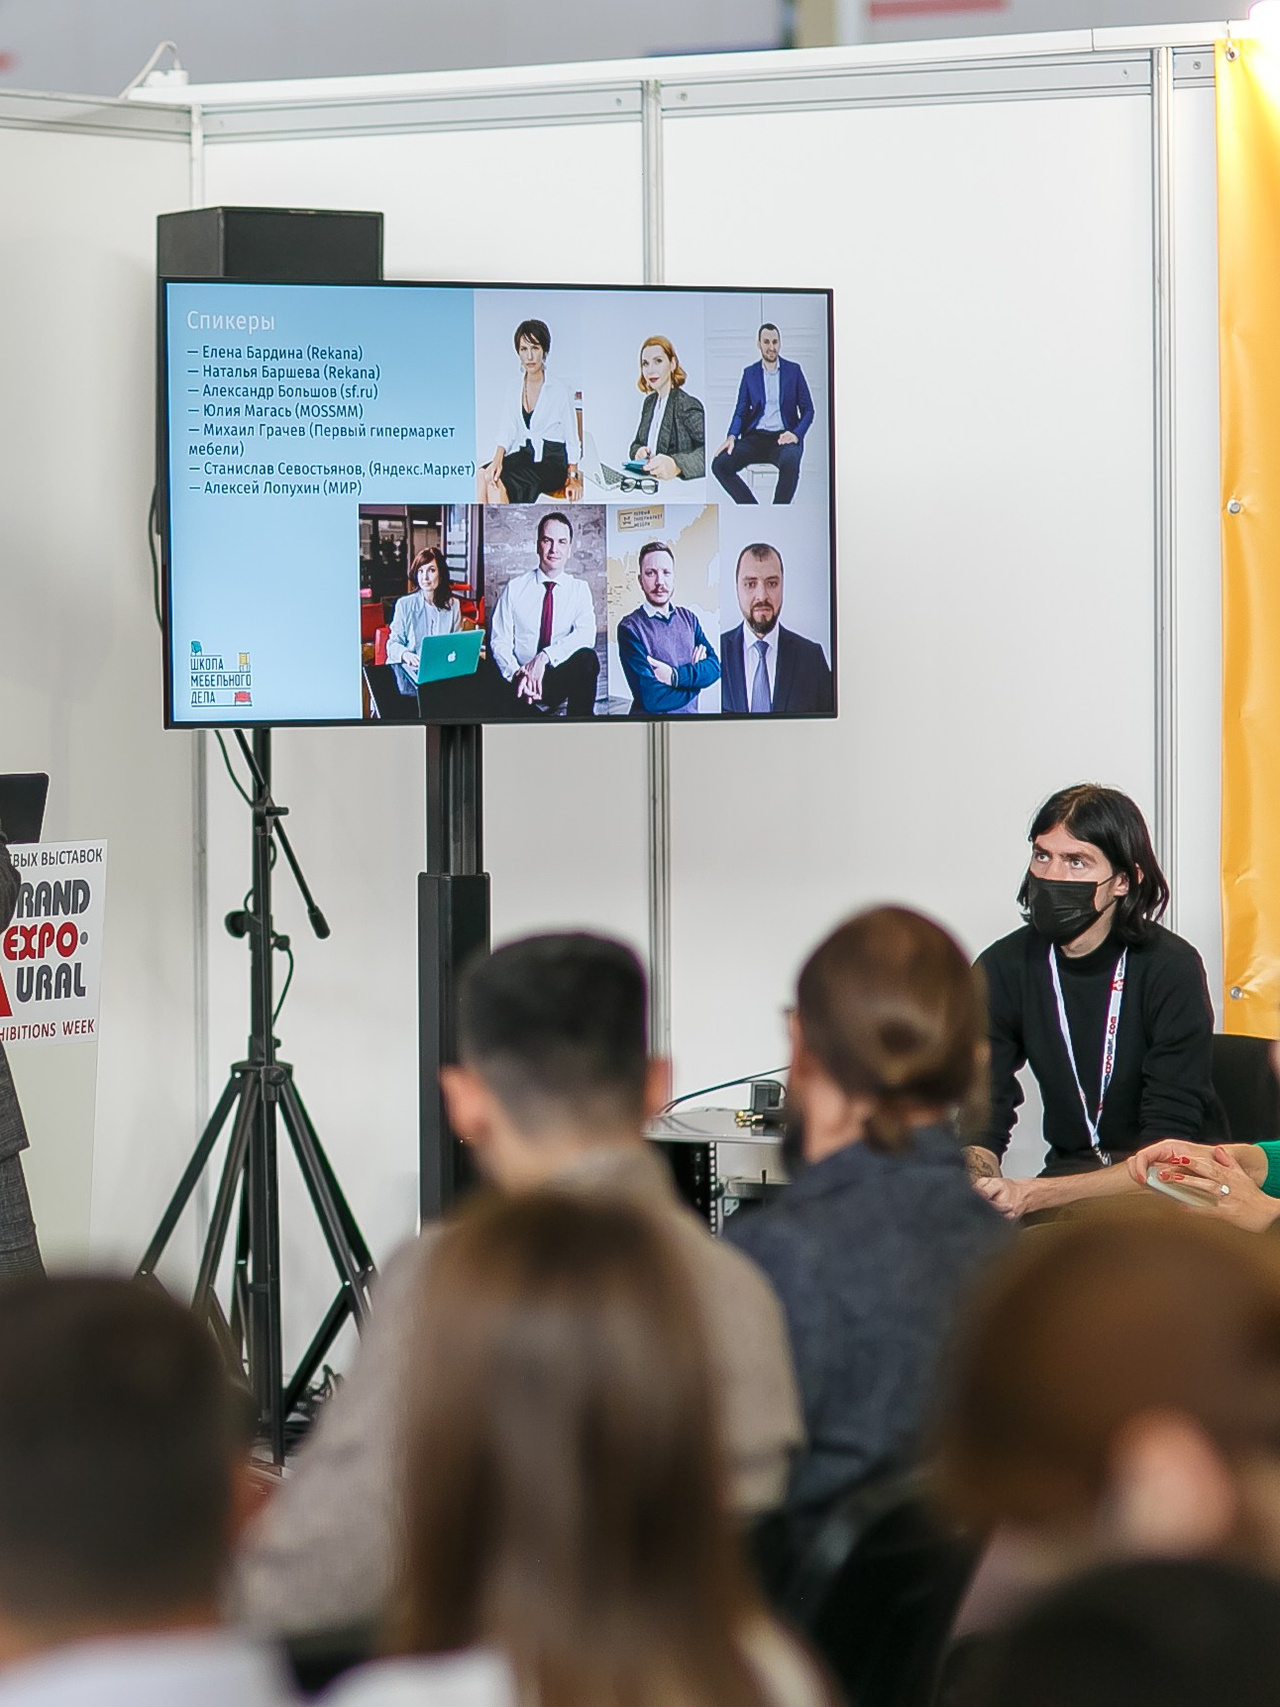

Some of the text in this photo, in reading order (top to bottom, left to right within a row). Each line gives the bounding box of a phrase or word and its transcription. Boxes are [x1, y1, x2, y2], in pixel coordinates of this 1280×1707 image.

[187, 311, 275, 334] Спикеры
[202, 344, 363, 362] Елена Бардина (Rekana)
[203, 364, 380, 381] Наталья Баршева (Rekana)
[203, 383, 378, 400] Александр Большов (sf.ru)
[203, 403, 364, 420] Юлия Магась (MOSSMM)
[203, 422, 455, 440] Михаил Грачев (Первый гипермаркет
[188, 440, 244, 457] мебели)
[204, 460, 475, 478] Станислав Севостьянов, (Яндекс.Маркет)
[204, 479, 362, 497] Алексей Лопухин (МИР)
[190, 658, 224, 670] ШКОЛА
[191, 674, 251, 687] МЕБЕЛЬНОГО
[191, 691, 215, 704] ДЕЛА
[10, 848, 103, 867] ВЫХ ВЫСТАВОК
[16, 962, 86, 1002] URAL
[62, 1019, 94, 1035] WEEK
